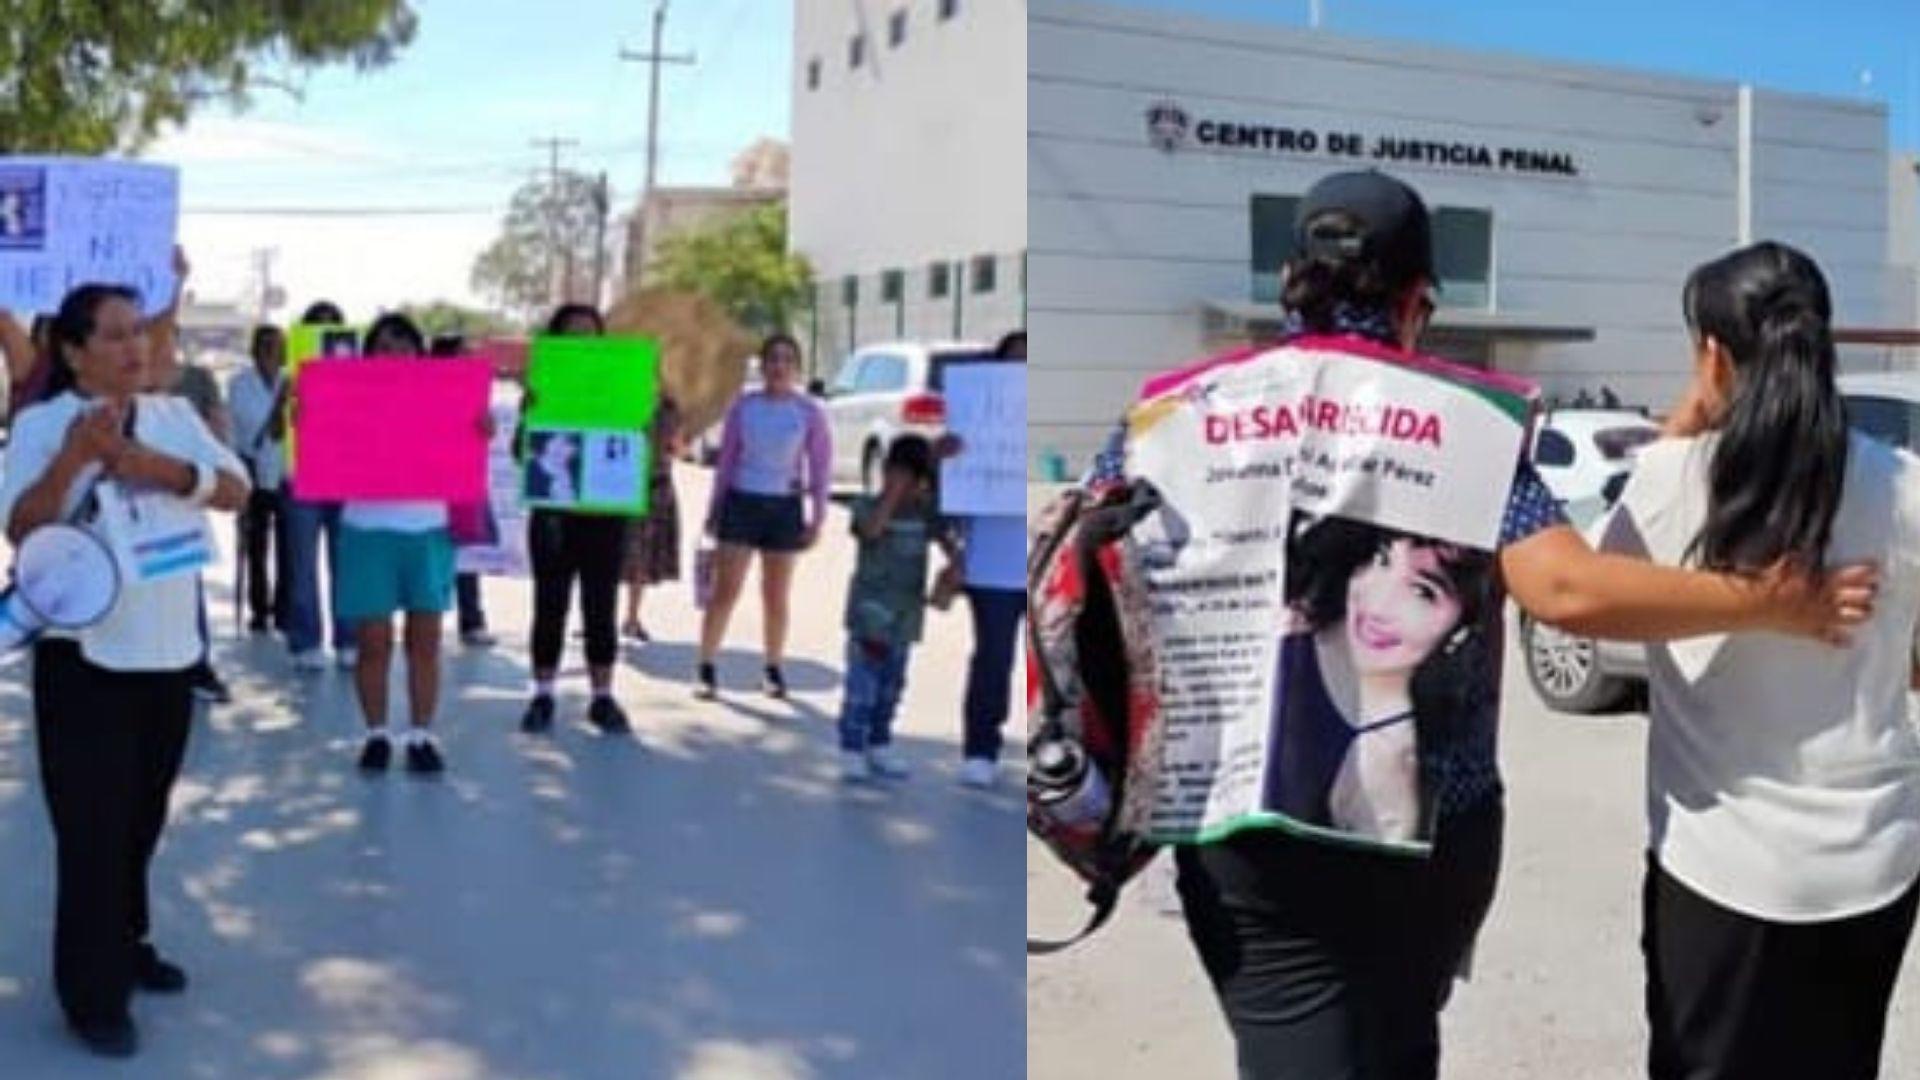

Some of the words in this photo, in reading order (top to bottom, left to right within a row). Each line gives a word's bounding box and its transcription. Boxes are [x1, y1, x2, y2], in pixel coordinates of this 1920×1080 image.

[1196, 121, 1318, 152] CENTRO
[1327, 132, 1363, 156] DE
[1373, 137, 1490, 167] JUSTICIA
[1500, 147, 1577, 175] PENAL
[1206, 396, 1441, 447] DESARIDA
